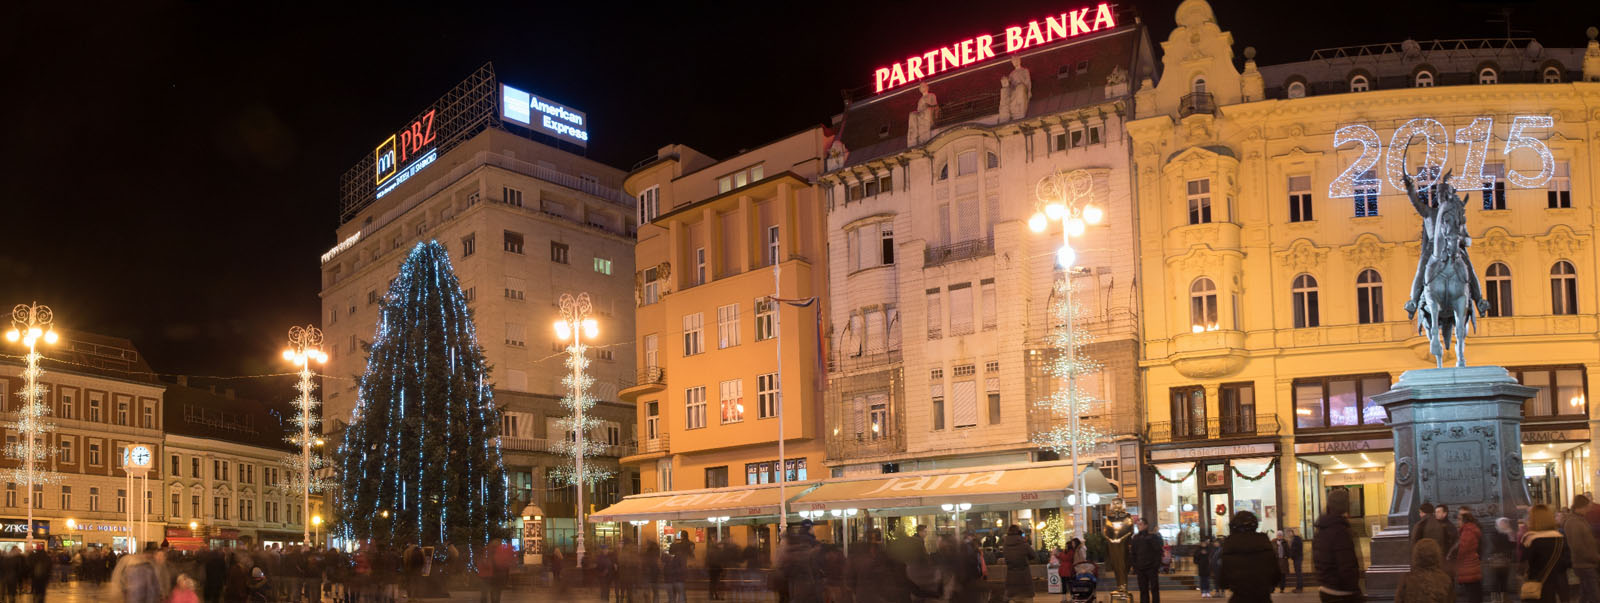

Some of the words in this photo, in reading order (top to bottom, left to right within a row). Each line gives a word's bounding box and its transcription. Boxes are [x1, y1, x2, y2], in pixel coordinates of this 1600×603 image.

[875, 34, 995, 93] PARTNER
[1006, 3, 1115, 53] BANKA
[531, 97, 582, 125] American
[400, 109, 437, 162] PBZ
[543, 115, 588, 140] Express
[1329, 116, 1555, 198] 2015
[1319, 440, 1371, 452] HARMICA
[1523, 432, 1566, 441] ARMICA
